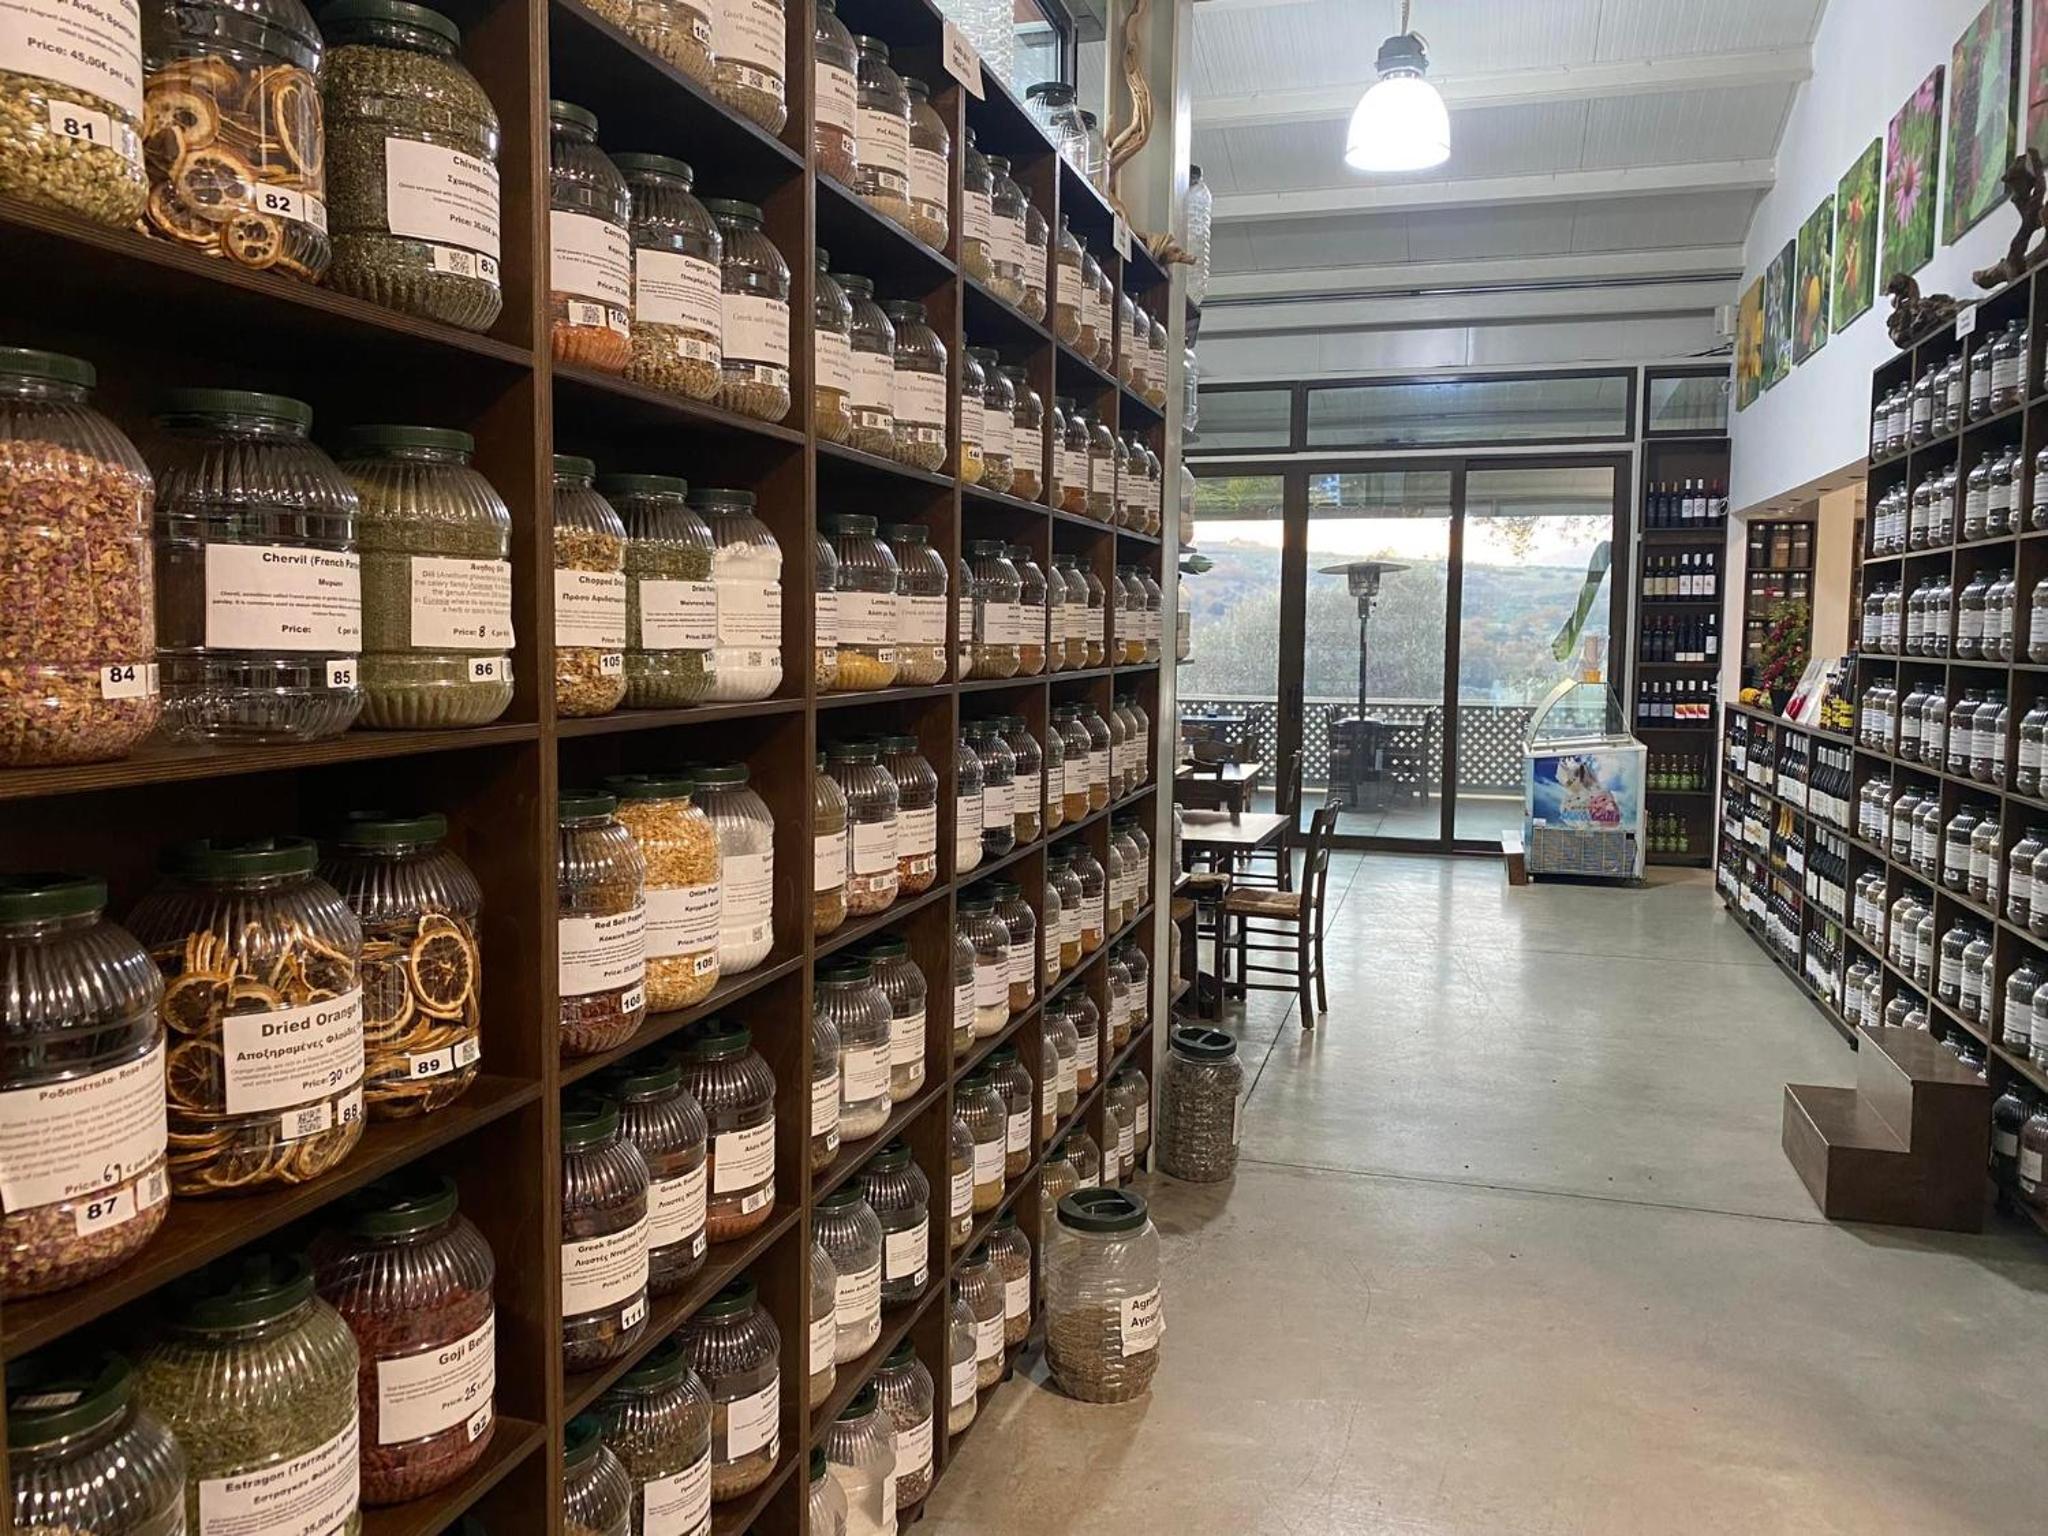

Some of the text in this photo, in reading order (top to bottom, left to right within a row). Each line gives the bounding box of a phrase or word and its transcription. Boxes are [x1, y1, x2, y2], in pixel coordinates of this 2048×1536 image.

[27, 37, 68, 56] Price:
[63, 117, 94, 140] 81
[453, 155, 481, 173] Chives
[265, 194, 292, 213] 82
[480, 259, 494, 275] 83
[262, 552, 308, 565] Chervil
[578, 575, 613, 587] Chopped
[281, 625, 312, 634] Price:
[479, 626, 486, 638] 8
[474, 663, 493, 676] 86
[602, 655, 621, 668] 105
[110, 666, 135, 683] 84
[333, 671, 351, 684] 85
[696, 957, 714, 971] 109
[262, 1017, 311, 1037] Dried
[236, 1040, 324, 1061] Αποξηραμένες
[417, 1058, 441, 1074] 89
[302, 1077, 328, 1090] Price:
[328, 1068, 343, 1087] 30
[343, 1103, 359, 1121] 88
[65, 1179, 102, 1195] Price:
[86, 1197, 117, 1220] 87
[578, 1241, 604, 1254] Greek
[623, 1308, 642, 1327] 111
[439, 1345, 466, 1366] Goji
[464, 1382, 477, 1401] 25
[473, 1415, 487, 1436] 92
[225, 1470, 285, 1493] Estragon
